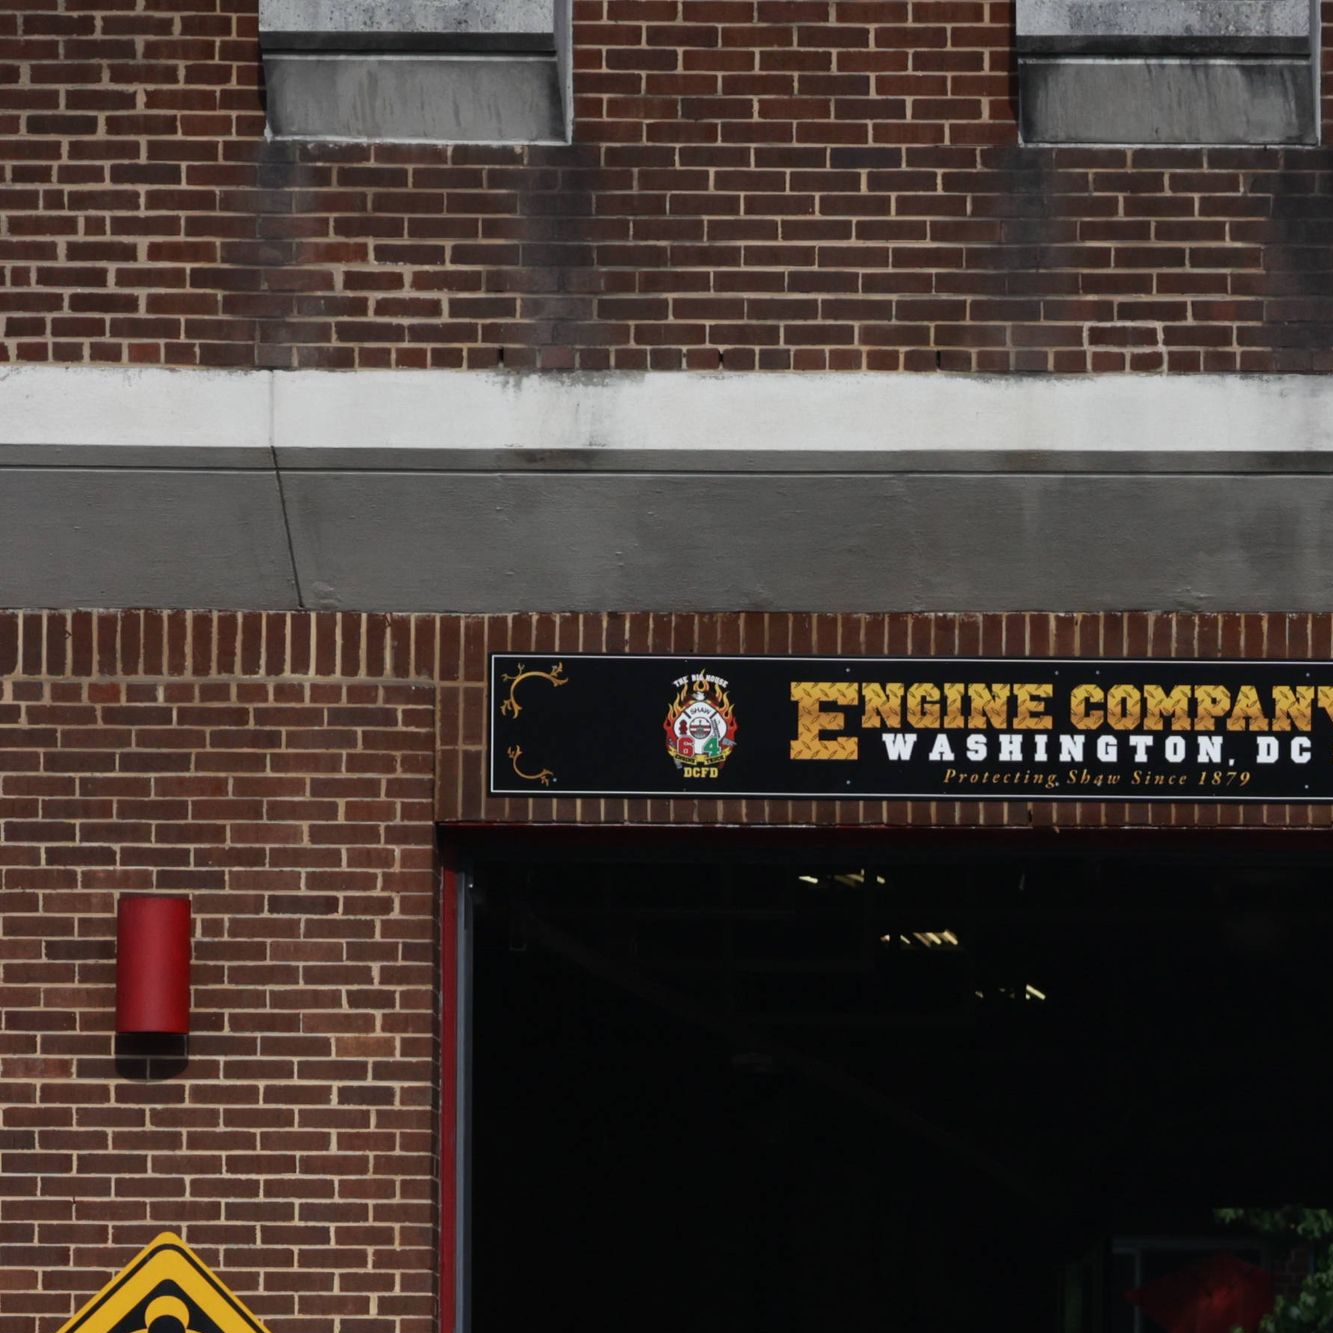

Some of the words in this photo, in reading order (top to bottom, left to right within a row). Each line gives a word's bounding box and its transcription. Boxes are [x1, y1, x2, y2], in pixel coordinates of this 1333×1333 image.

[790, 681, 1054, 761] ENGINE
[882, 732, 1237, 767] WASHINGTON,
[1256, 735, 1312, 764] DC
[683, 767, 719, 778] DCFD
[943, 768, 1059, 788] Protecting
[1066, 768, 1122, 786] Shaw
[1131, 769, 1192, 786] Since
[1198, 770, 1253, 787] 1879
